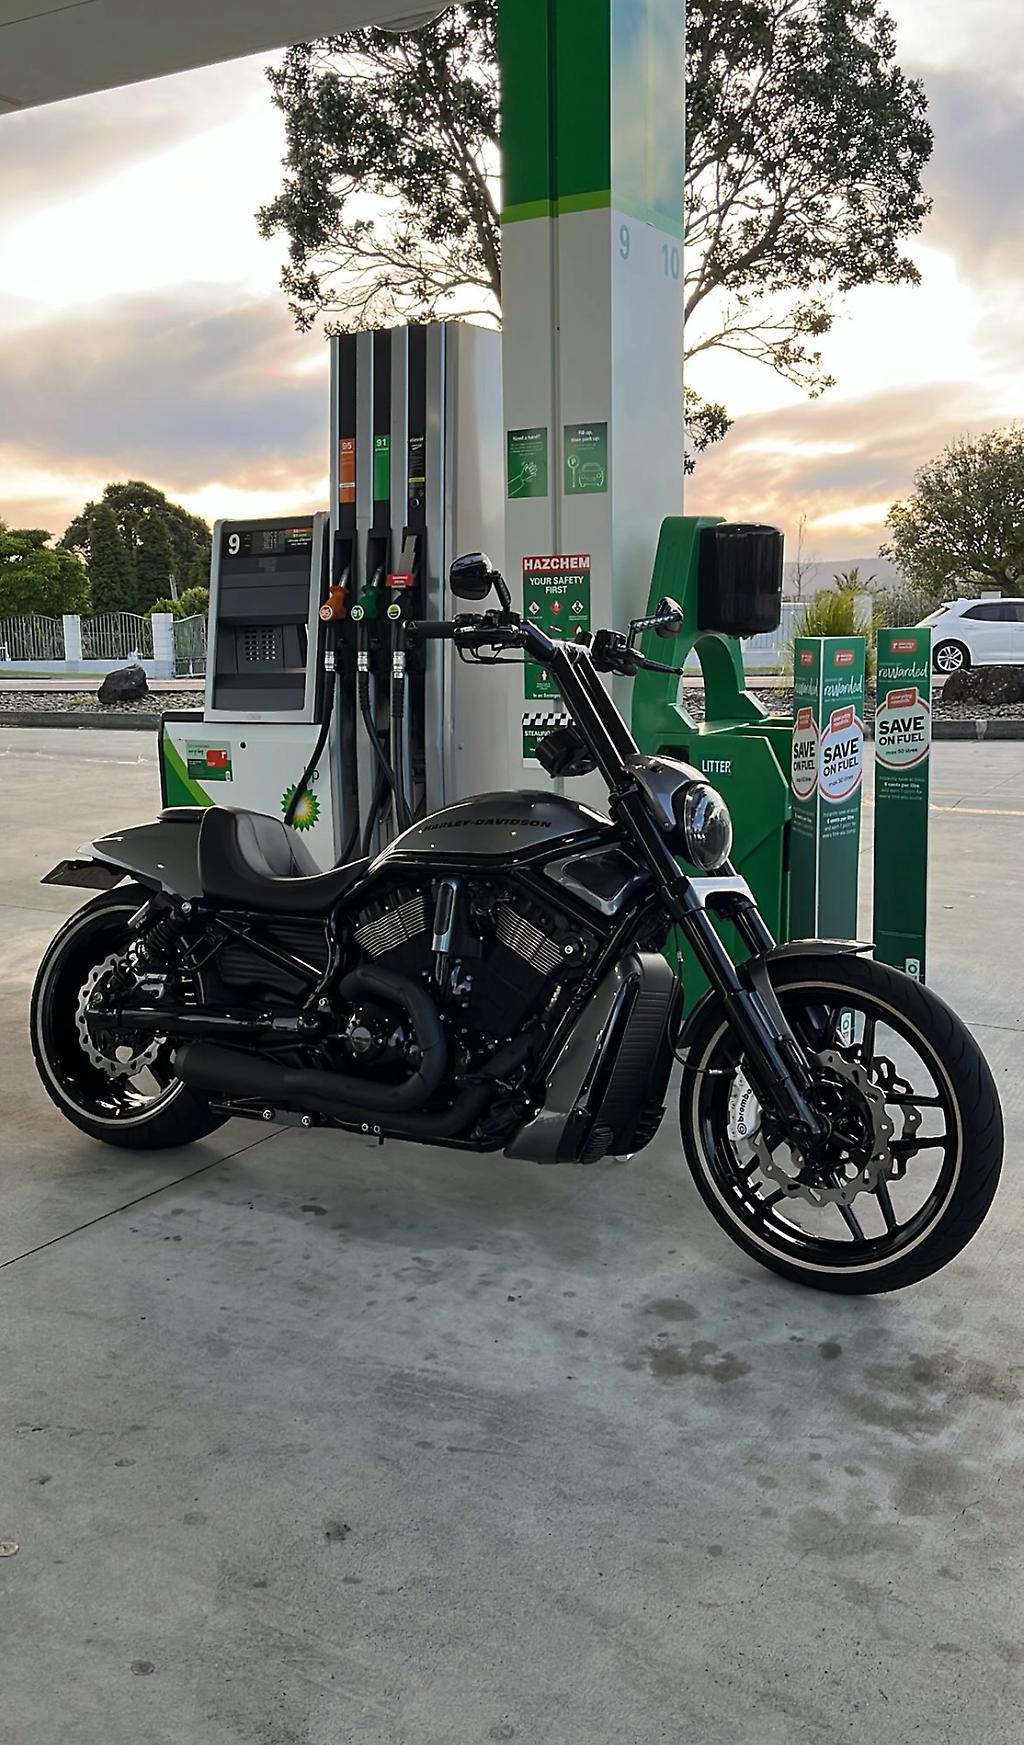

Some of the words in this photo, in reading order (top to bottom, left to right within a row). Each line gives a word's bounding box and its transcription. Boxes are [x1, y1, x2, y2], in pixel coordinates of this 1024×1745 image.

[620, 224, 629, 259] 9
[662, 244, 679, 280] 10
[342, 441, 352, 450] 95
[376, 438, 386, 446] 91
[228, 533, 240, 554] 9
[524, 557, 590, 570] HAZCHEM
[529, 577, 552, 585] YOUR
[553, 576, 584, 584] SAFETY
[545, 586, 567, 594] FIRST
[879, 661, 928, 679] rewarded
[824, 675, 863, 696] rewarded
[879, 716, 924, 735] SAVE
[879, 736, 895, 746] ON
[897, 733, 924, 745] FUEL
[794, 741, 815, 759] SAVE
[824, 737, 859, 764] SAVE
[702, 760, 731, 773] LITTER
[794, 761, 801, 771] ON
[801, 760, 815, 770] FUEL
[823, 764, 836, 777] ON
[837, 757, 859, 771] FUEL
[303, 766, 320, 783] p
[423, 818, 552, 831] HARLEY-DAVIDSON
[738, 1088, 752, 1122] brembo
